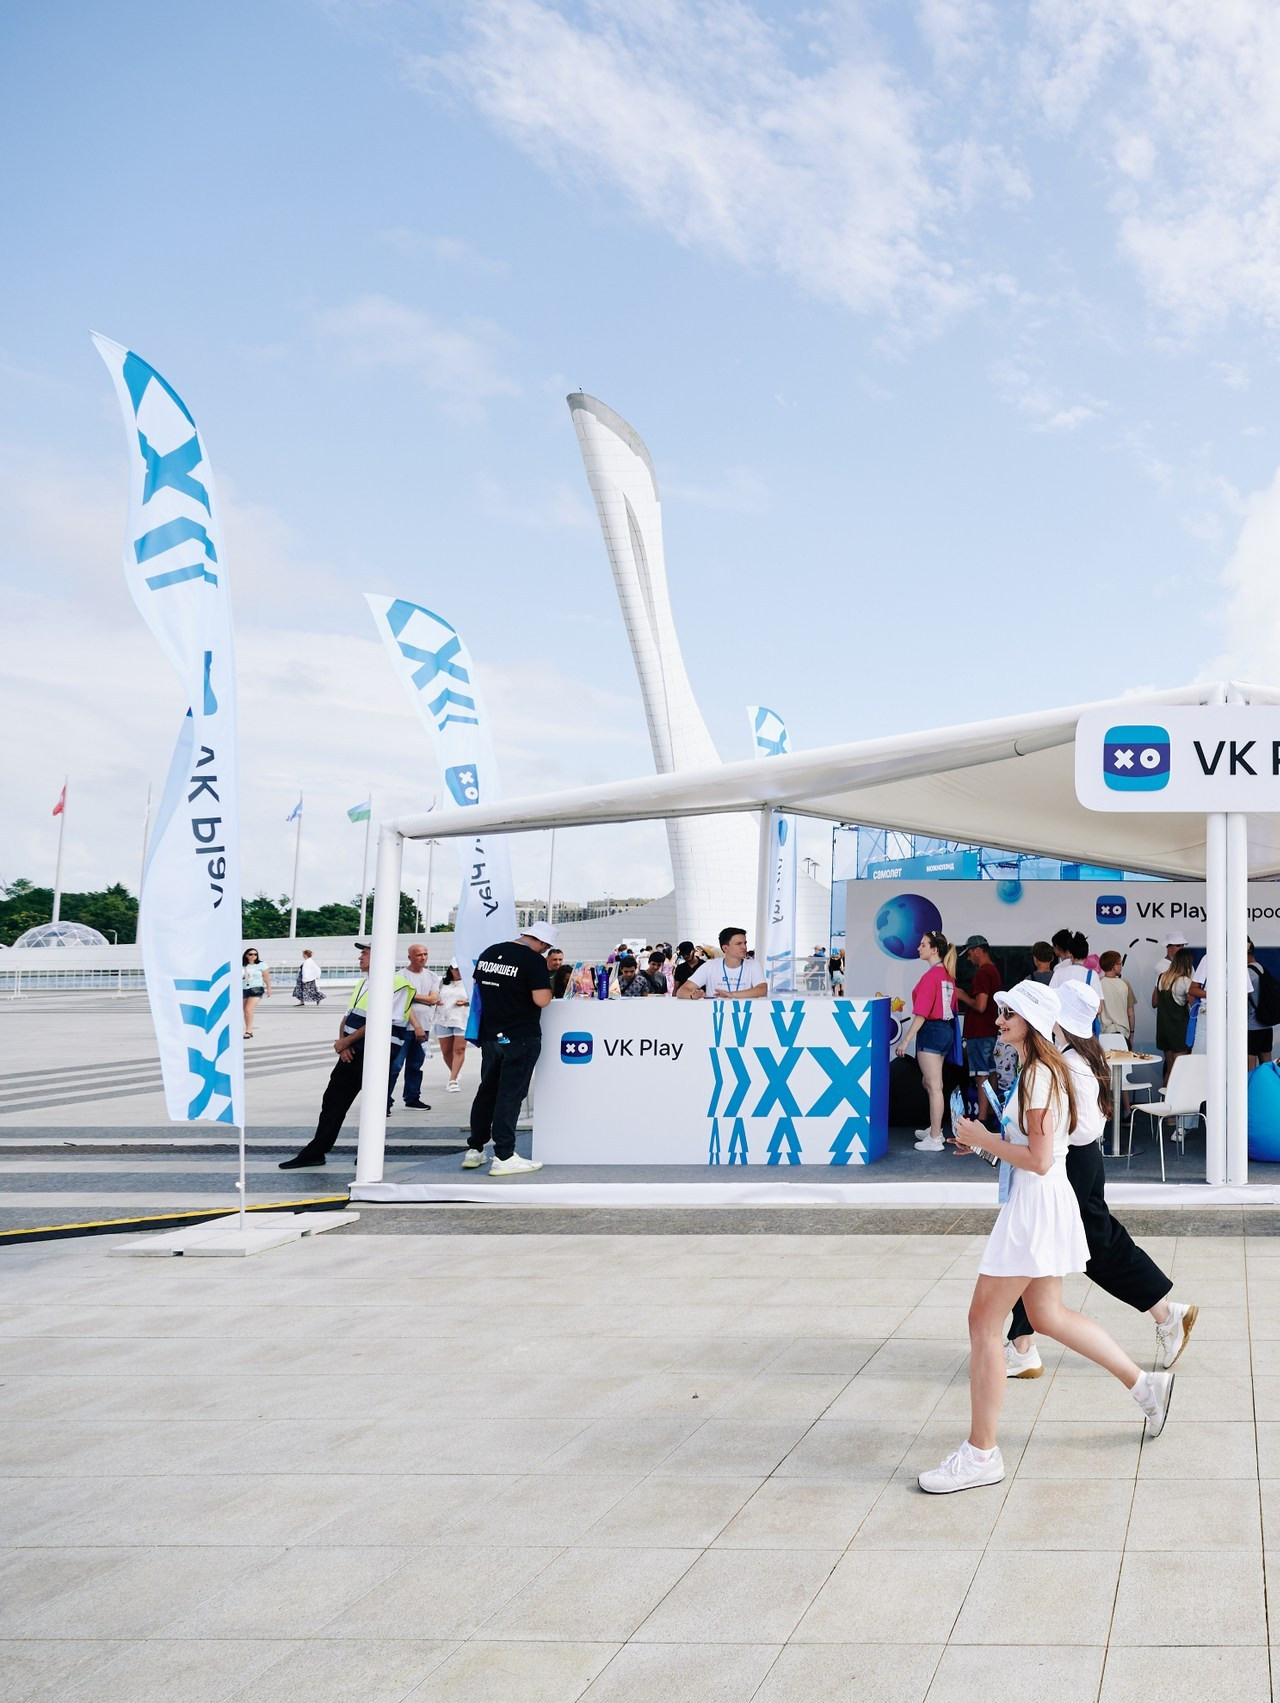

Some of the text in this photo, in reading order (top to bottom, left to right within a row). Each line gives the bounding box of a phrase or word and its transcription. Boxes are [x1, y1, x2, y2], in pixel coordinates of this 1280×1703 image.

[1193, 740, 1258, 776] VK
[1136, 902, 1165, 919] VK
[1170, 902, 1207, 922] Play
[603, 1039, 684, 1061] VK Play
